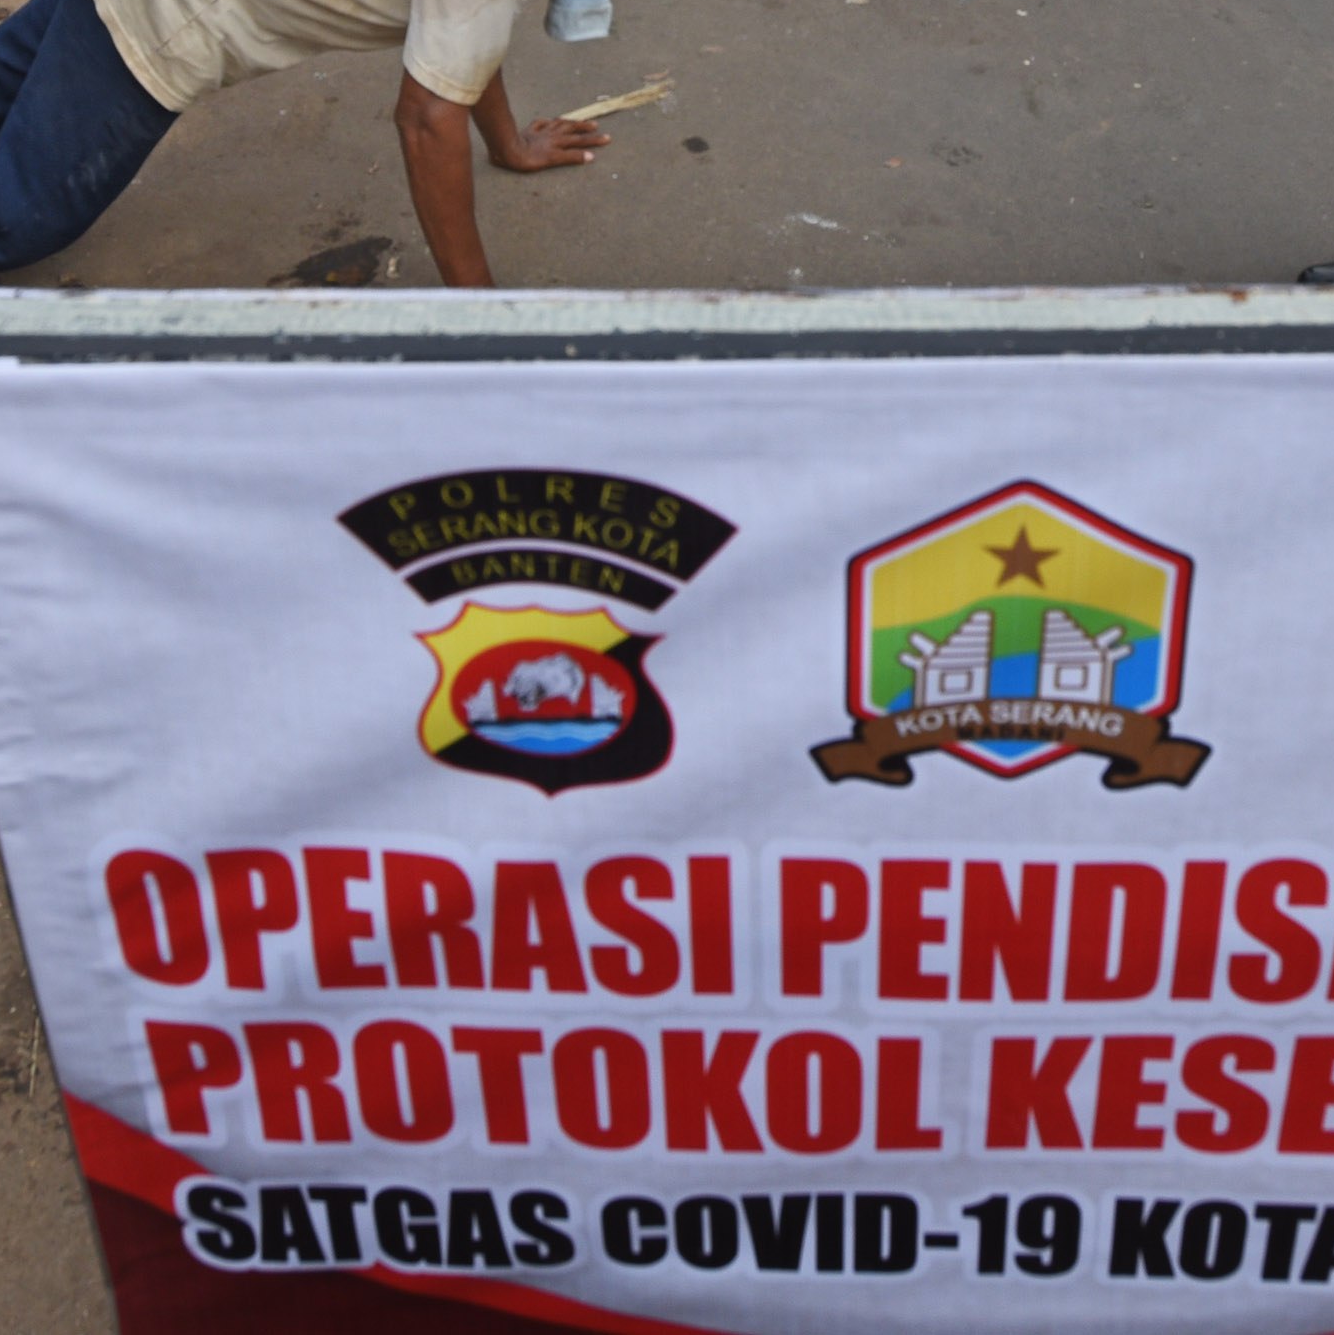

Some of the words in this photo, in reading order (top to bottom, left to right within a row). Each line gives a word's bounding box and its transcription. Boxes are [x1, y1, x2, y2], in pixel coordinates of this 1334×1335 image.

[388, 475, 682, 530] POLRES
[387, 509, 559, 558] SERANG
[572, 511, 680, 570] KOTA
[450, 553, 626, 594] BANTEN
[894, 703, 984, 737] KOTA
[989, 700, 1125, 736] SERANG
[105, 847, 734, 996] OPERASI
[144, 1019, 943, 1154] PROTOKOL
[186, 1185, 575, 1268] SATGAS
[601, 1193, 1082, 1276] COVID-19
